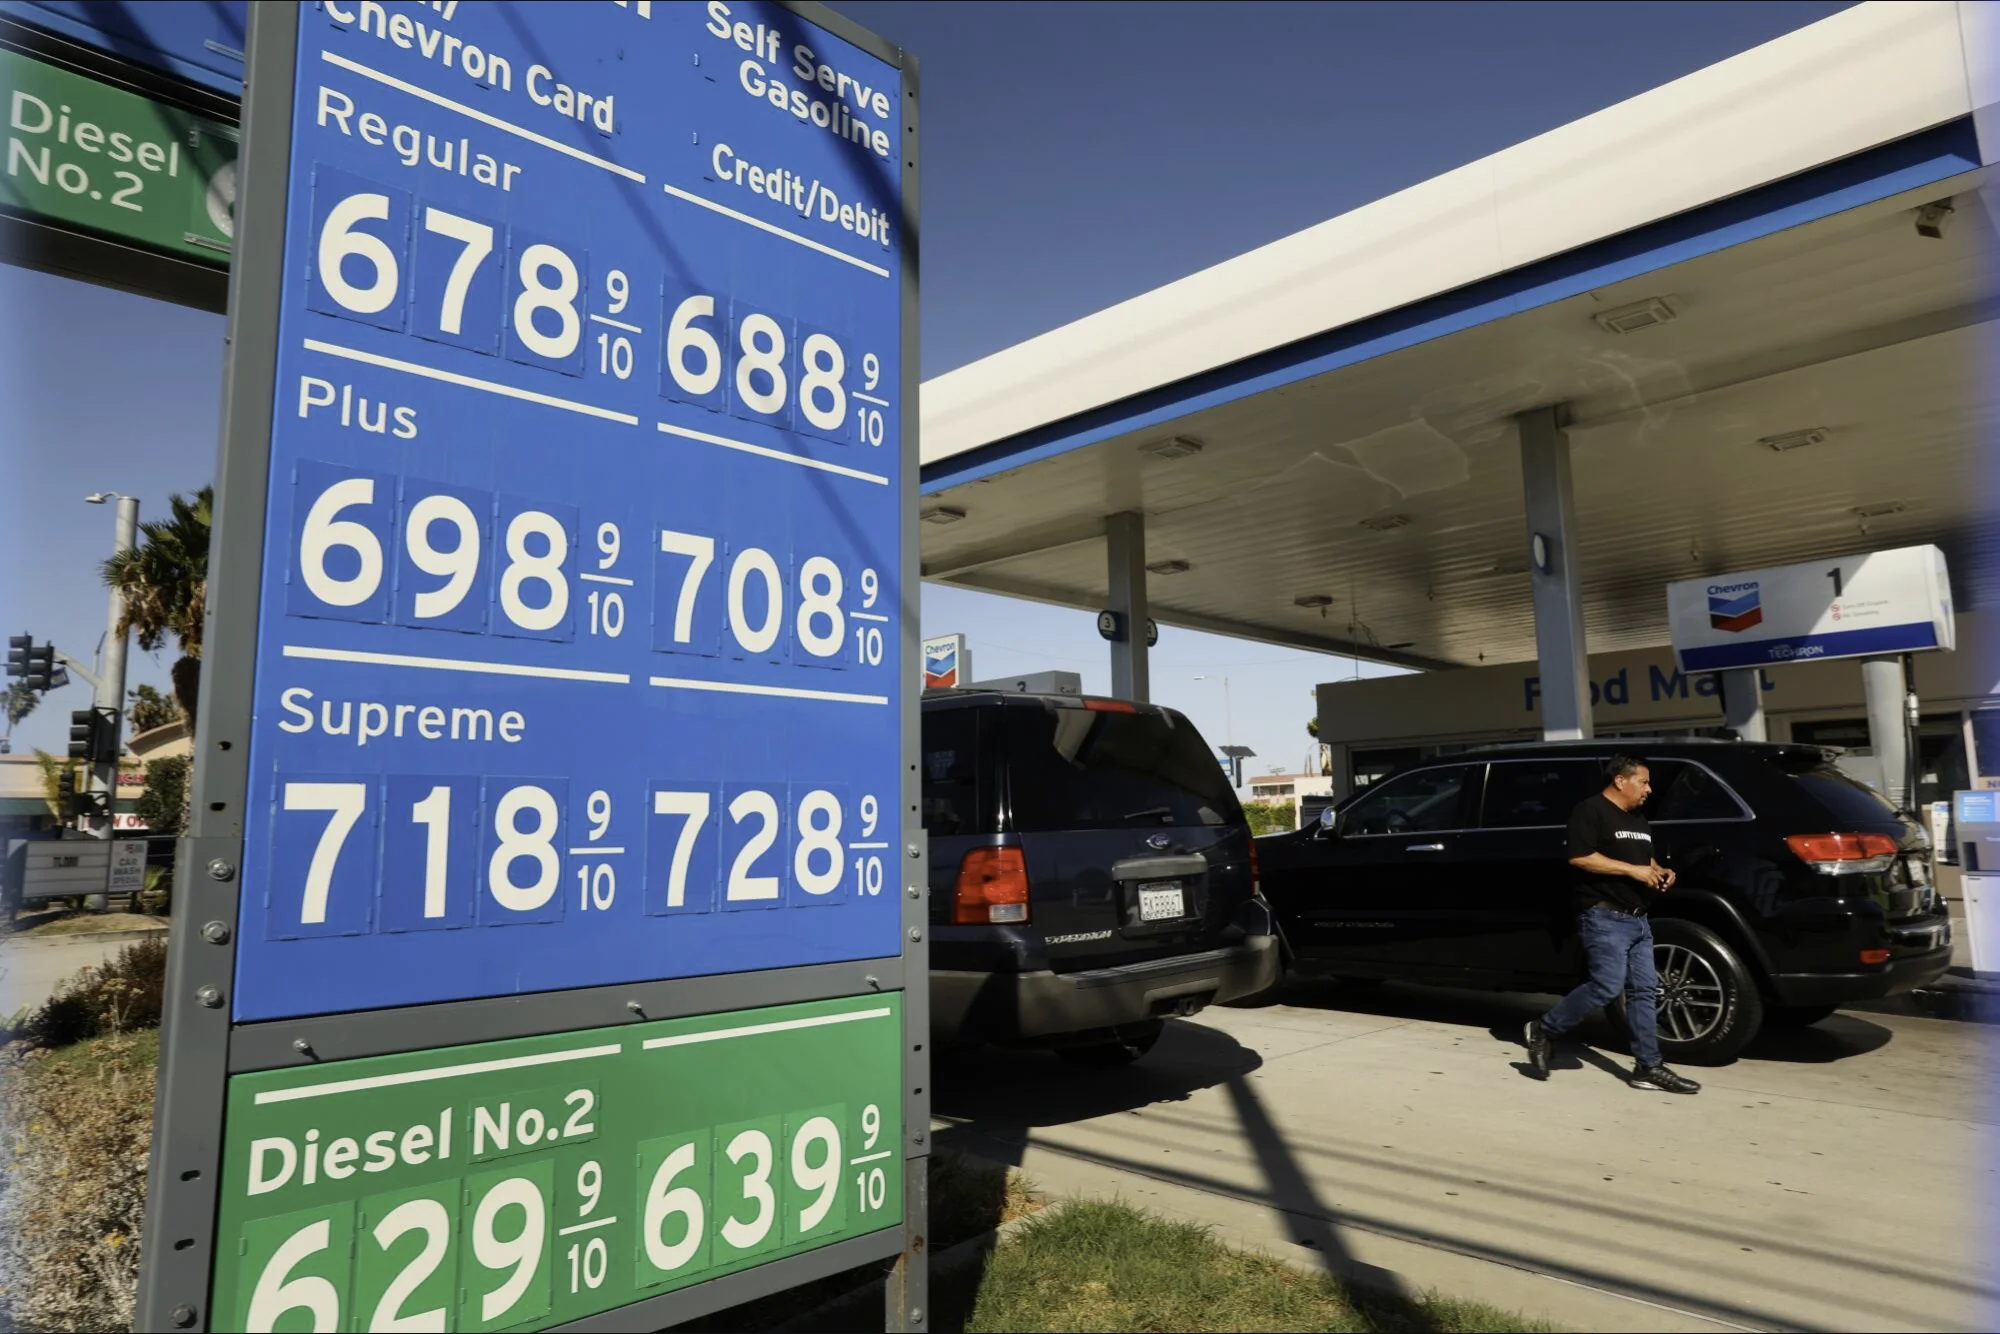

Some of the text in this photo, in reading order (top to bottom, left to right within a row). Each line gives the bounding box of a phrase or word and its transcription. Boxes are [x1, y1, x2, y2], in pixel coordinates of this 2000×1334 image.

[322, 1, 614, 134] Chevron Card
[705, 1, 890, 120] Self Serve
[739, 59, 890, 158] Gasoline
[7, 137, 144, 212] No.2
[9, 89, 180, 178] Diesel
[317, 85, 522, 193] Regular
[712, 143, 890, 247] Credit/Debit
[317, 192, 634, 380] 678 9 10
[298, 375, 418, 440] Plus
[666, 294, 884, 447] 688 9 10
[299, 478, 625, 638] 698 9 10
[660, 529, 883, 667] 708 9 10
[1707, 581, 1760, 596] Chevron
[1826, 567, 1843, 597] 1
[925, 641, 956, 656] Chevron
[1524, 665, 1776, 711] Fd Mat
[278, 687, 526, 747] Supreme
[283, 782, 616, 924] 718 9 10
[654, 789, 883, 908] 728 9 10
[246, 1088, 595, 1196] Diesel No.2
[643, 1103, 886, 1271] 639 9 10
[244, 1160, 608, 1333] 629 9 10
